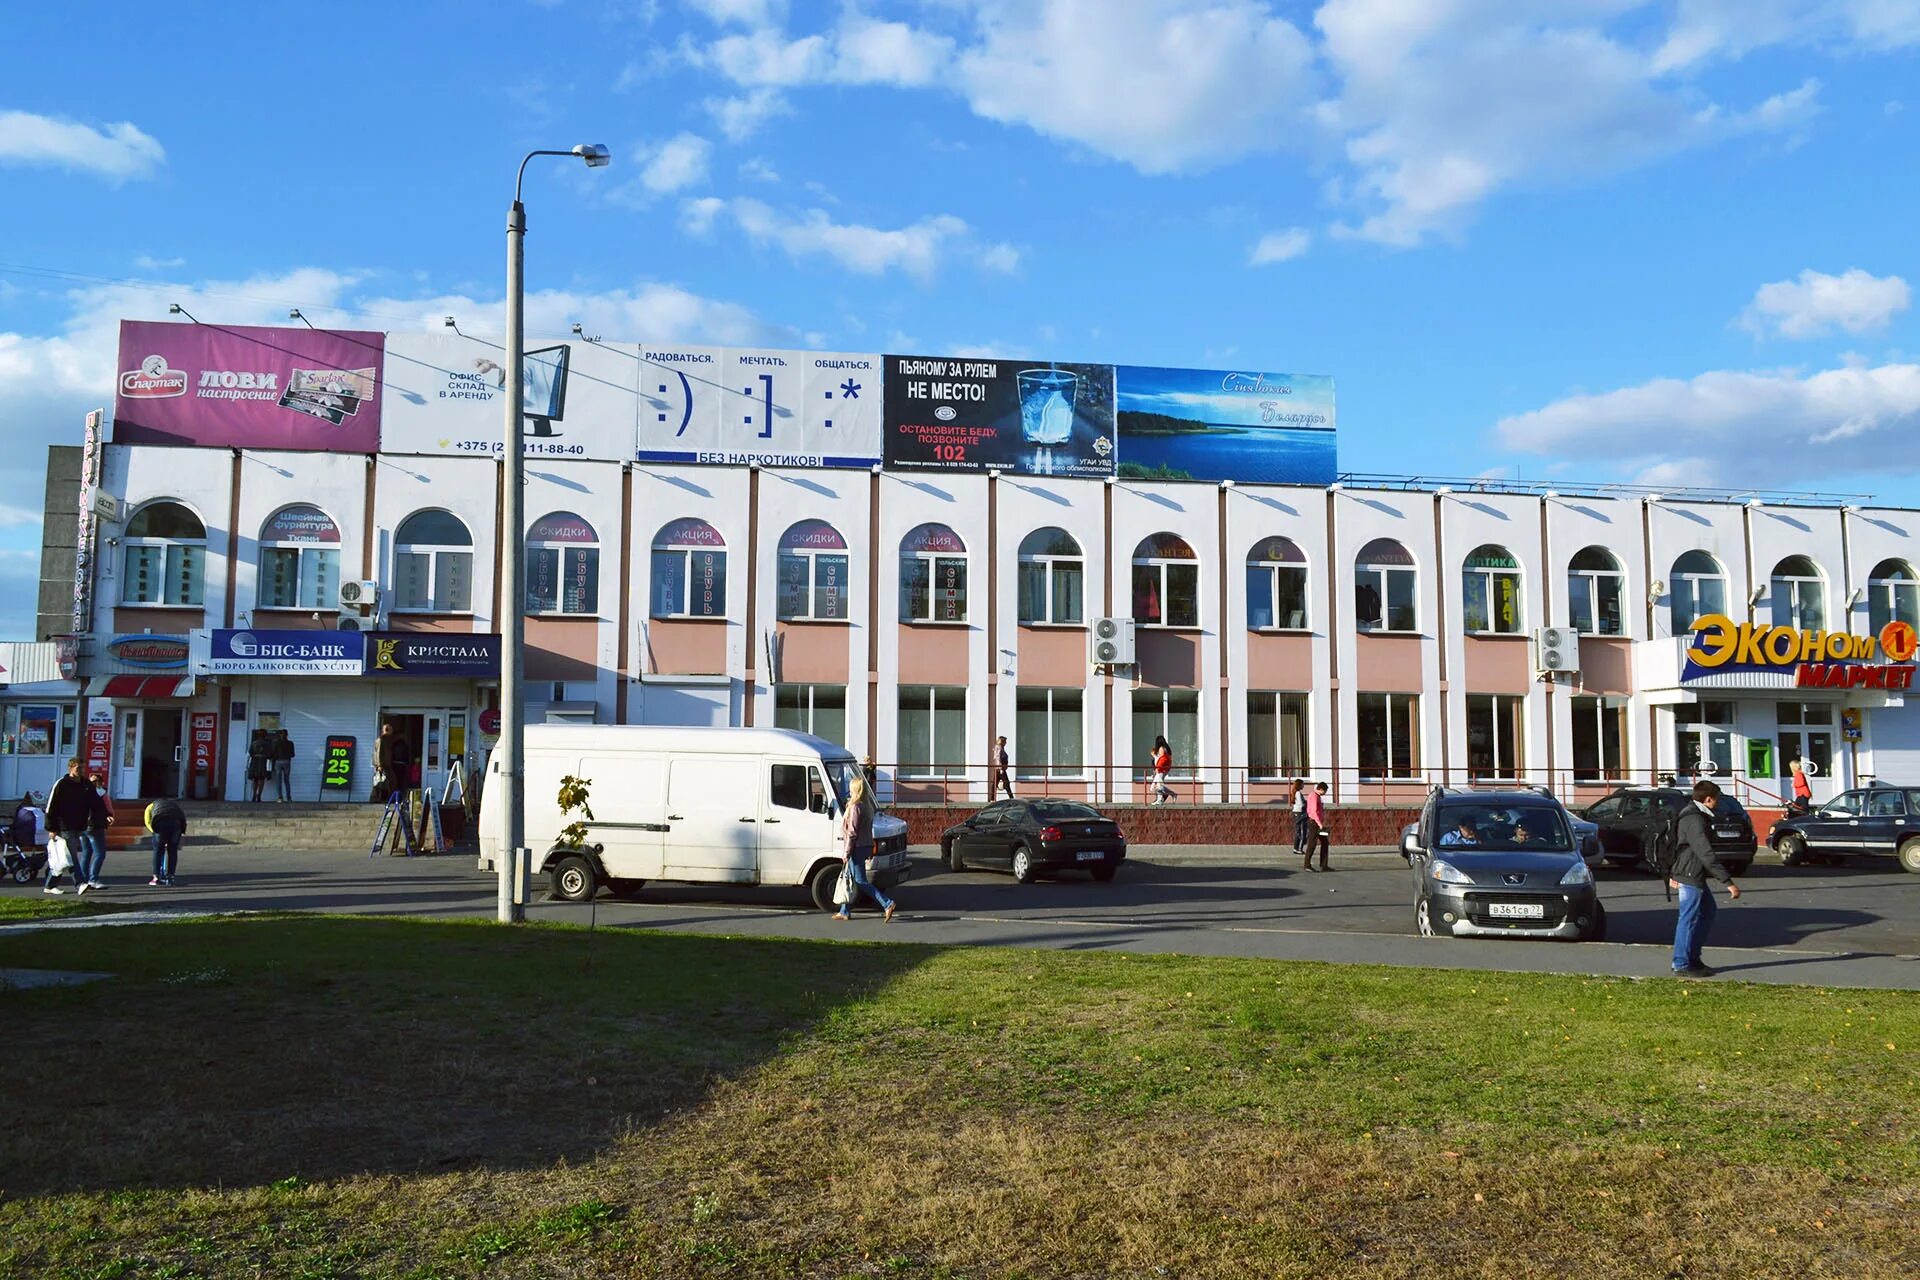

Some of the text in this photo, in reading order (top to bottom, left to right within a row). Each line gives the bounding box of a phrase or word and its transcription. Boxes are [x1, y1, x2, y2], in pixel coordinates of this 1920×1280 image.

[645, 352, 714, 364] РАДОВАТЬСЯ.
[739, 356, 788, 367] МЕЧТАТЬ.
[814, 359, 873, 370] ОБЩАТЬСЯ.
[899, 360, 997, 378] ПЬЯНОМУ ЗА РУЛЕМ
[123, 372, 183, 391] Спартак
[448, 382, 486, 391] СКЛАД
[196, 388, 278, 401] настроение
[449, 391, 494, 400] АРЕНДУ
[907, 381, 986, 401] НЕ МЕСТО!
[899, 424, 998, 438] ОСТАНОВИТЕ БЕДУ,
[455, 441, 487, 451] +375
[917, 434, 979, 445] ПОЗВОНИТЕ
[700, 452, 821, 466] БЕЗ НАРКОТИКОВ!
[933, 445, 965, 461] 102
[539, 526, 587, 537] СКИДКИ
[673, 529, 713, 541] АКЦИЯ
[791, 534, 836, 544] СКИДКИ
[914, 536, 951, 546] АКЦИЯ
[1468, 557, 1517, 568] ОПТИКА
[577, 550, 587, 612] ОБУВЬ
[703, 553, 713, 614] ОБУВЬ
[826, 566, 837, 617] СУМКИ
[946, 568, 956, 619] СУМКИ
[1502, 578, 1513, 625] ВРАЧ
[1687, 613, 1876, 667] ЭКОНОМ
[261, 643, 345, 657] БПС-БАНК
[408, 646, 489, 657] КРИСТАЛЛ
[214, 662, 358, 672] БЮРО БАНКОВСКИХ УСЛУГ
[1794, 662, 1917, 689] МАРКЕТ
[327, 759, 350, 774] 25
